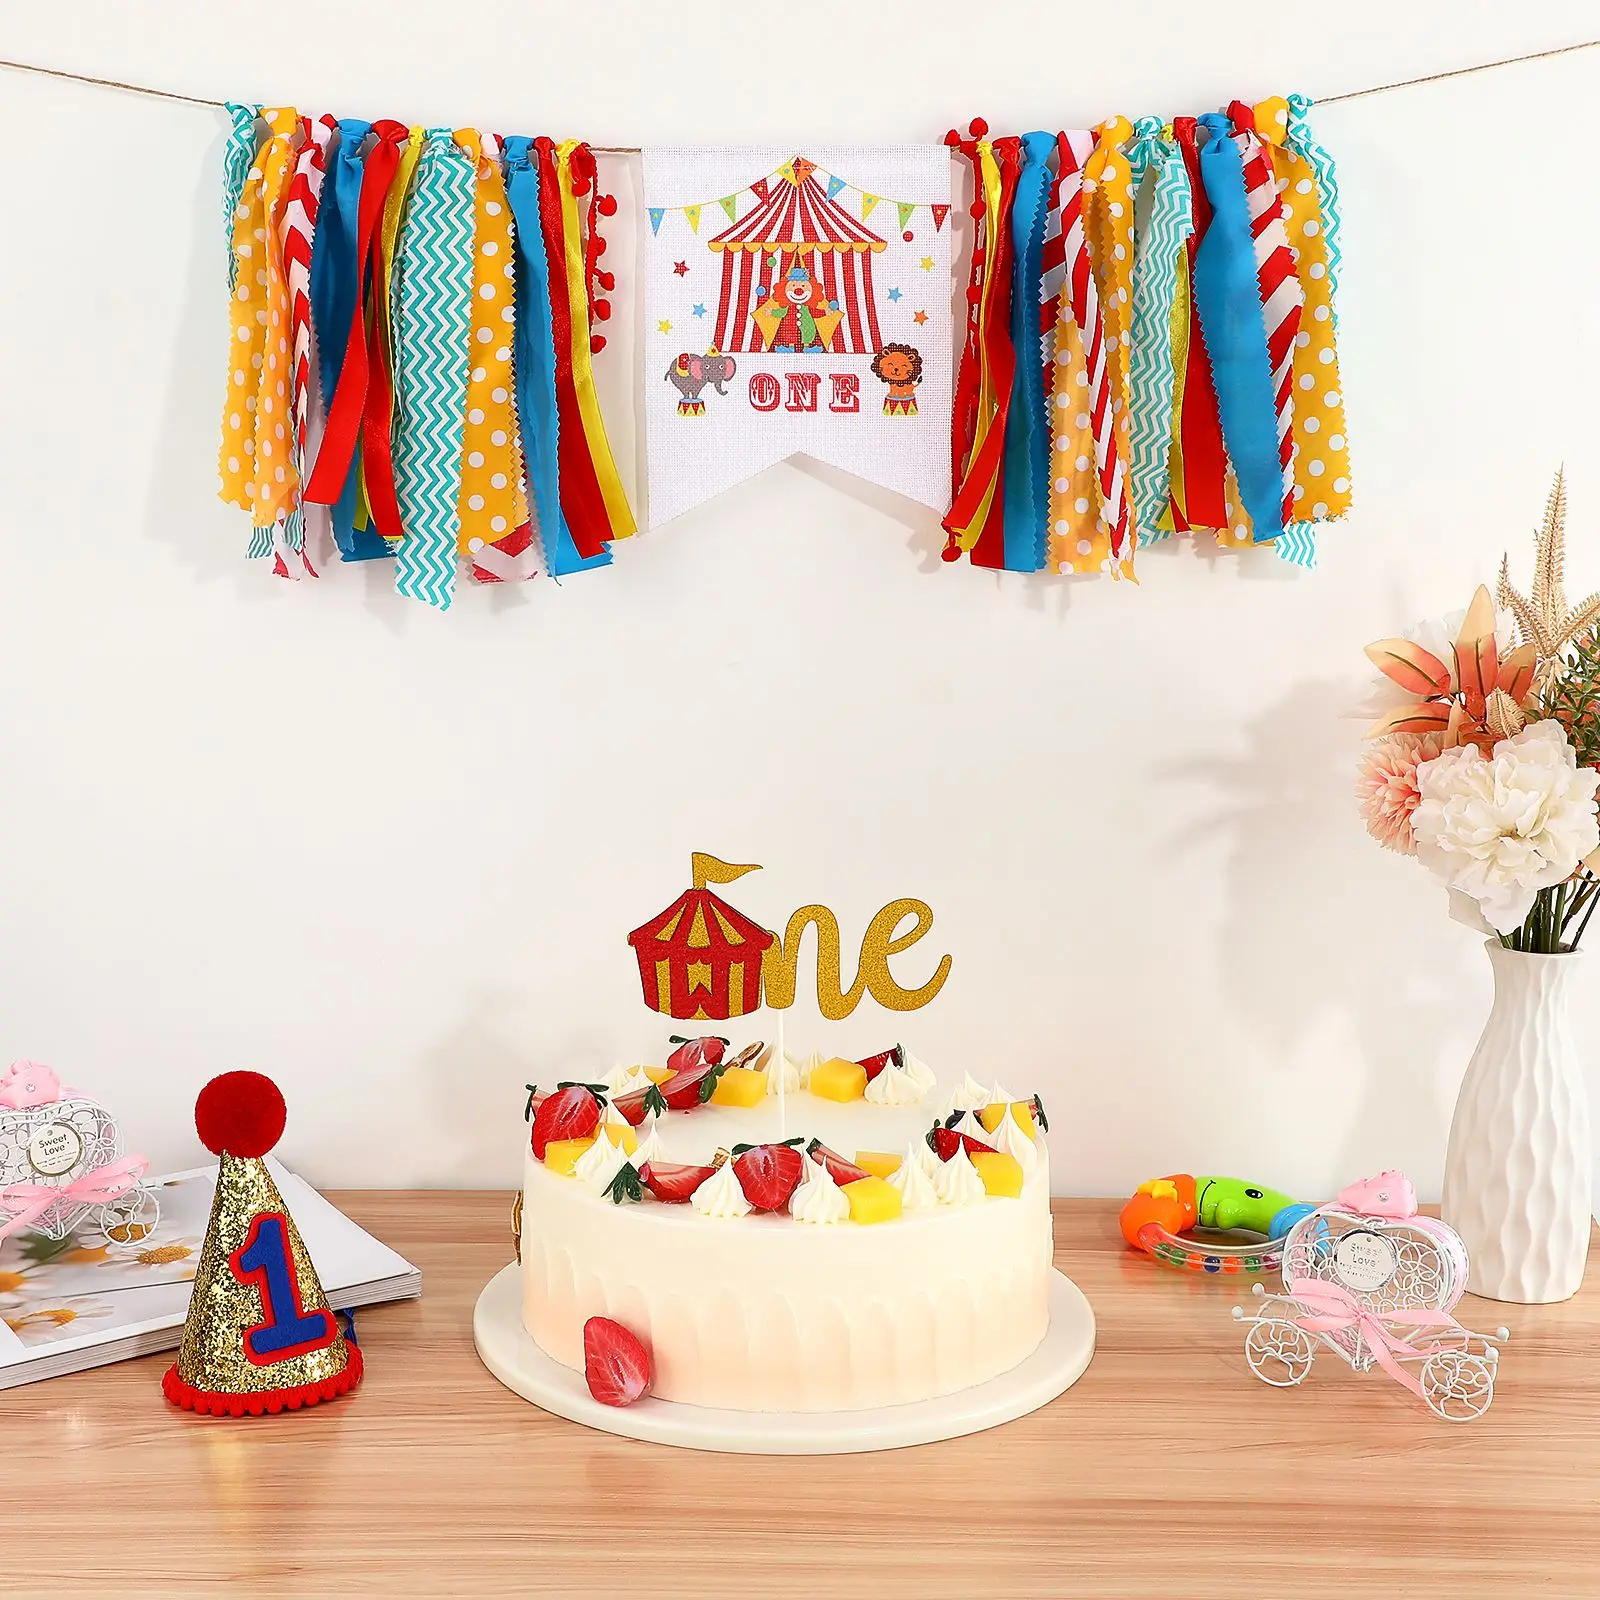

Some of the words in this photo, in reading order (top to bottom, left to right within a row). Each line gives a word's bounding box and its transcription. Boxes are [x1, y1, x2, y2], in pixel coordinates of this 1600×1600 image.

[748, 372, 860, 413] ONE
[38, 1133, 68, 1149] Sweet
[44, 1144, 66, 1156] Love
[1352, 1253, 1376, 1268] Love
[228, 1211, 339, 1367] 1
